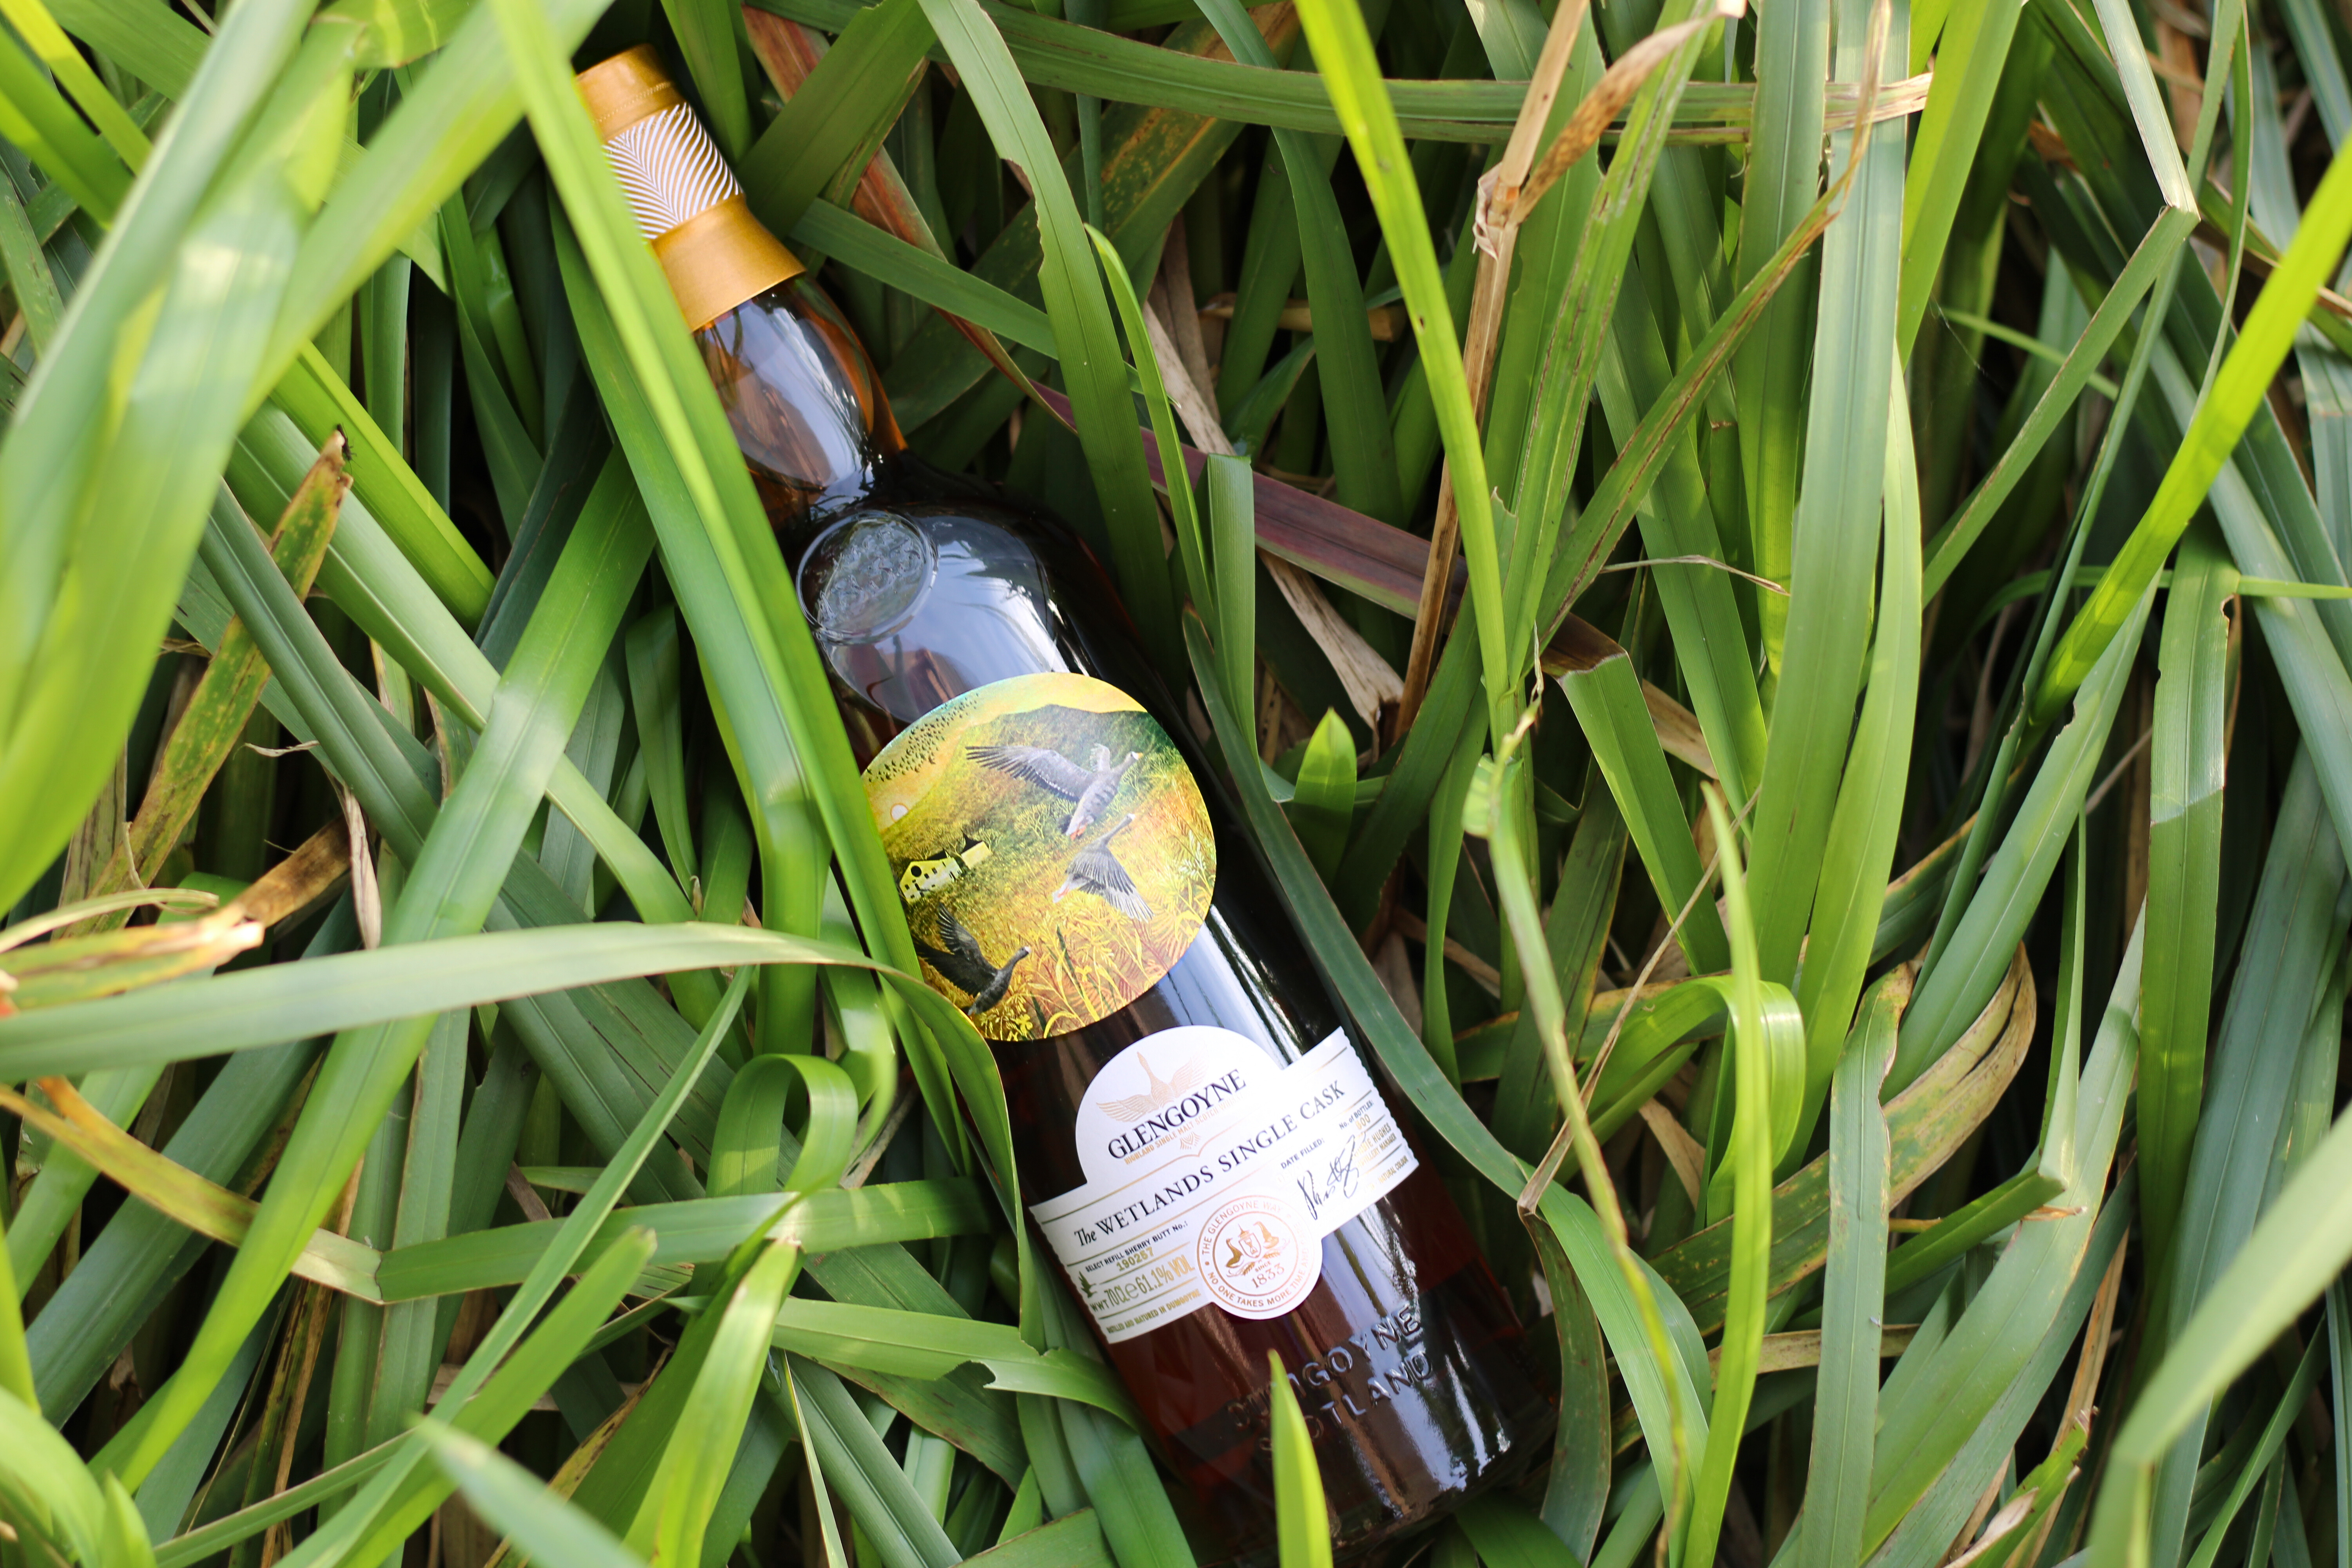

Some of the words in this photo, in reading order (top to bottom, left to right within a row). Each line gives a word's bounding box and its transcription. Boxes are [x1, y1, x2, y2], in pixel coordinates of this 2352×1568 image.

[1108, 1069, 1247, 1160] GLENGOYNE
[1372, 1122, 1392, 1143] HUGHES
[1124, 1144, 1154, 1165] HIGHLAND
[1155, 1133, 1178, 1148] SINGLE
[1178, 1122, 1194, 1134] MALT
[1196, 1108, 1219, 1125] SCOTCH
[1280, 1153, 1299, 1170] DATE
[1299, 1138, 1325, 1157] FILLED:
[1074, 1228, 1097, 1247] The
[1095, 1165, 1214, 1235] WETLANDS
[1218, 1114, 1298, 1172] SINGLE
[1300, 1080, 1345, 1119] CASK
[1377, 1168, 1397, 1185] NATURAL
[1395, 1155, 1409, 1172] COLOUR
[1202, 1236, 1212, 1255] THE
[1208, 1200, 1259, 1234] GLENGOYNE
[1263, 1201, 1283, 1213] WAY
[1085, 1261, 1104, 1272] SELECT
[1105, 1252, 1125, 1265] REFILL
[1125, 1238, 1151, 1255] SHERRY
[1152, 1229, 1171, 1243] BUTT
[1255, 1261, 1271, 1272] SINCE
[1135, 1265, 1174, 1294] 61.1%
[1168, 1254, 1196, 1278] VOL
[1208, 1272, 1219, 1285] NO
[1218, 1285, 1237, 1300] ONE
[1237, 1296, 1264, 1307] TAKES
[1267, 1287, 1292, 1305] MORE
[1290, 1270, 1306, 1289] TIME
[1251, 1263, 1285, 1289] 1833
[1090, 1299, 1110, 1312] WWT
